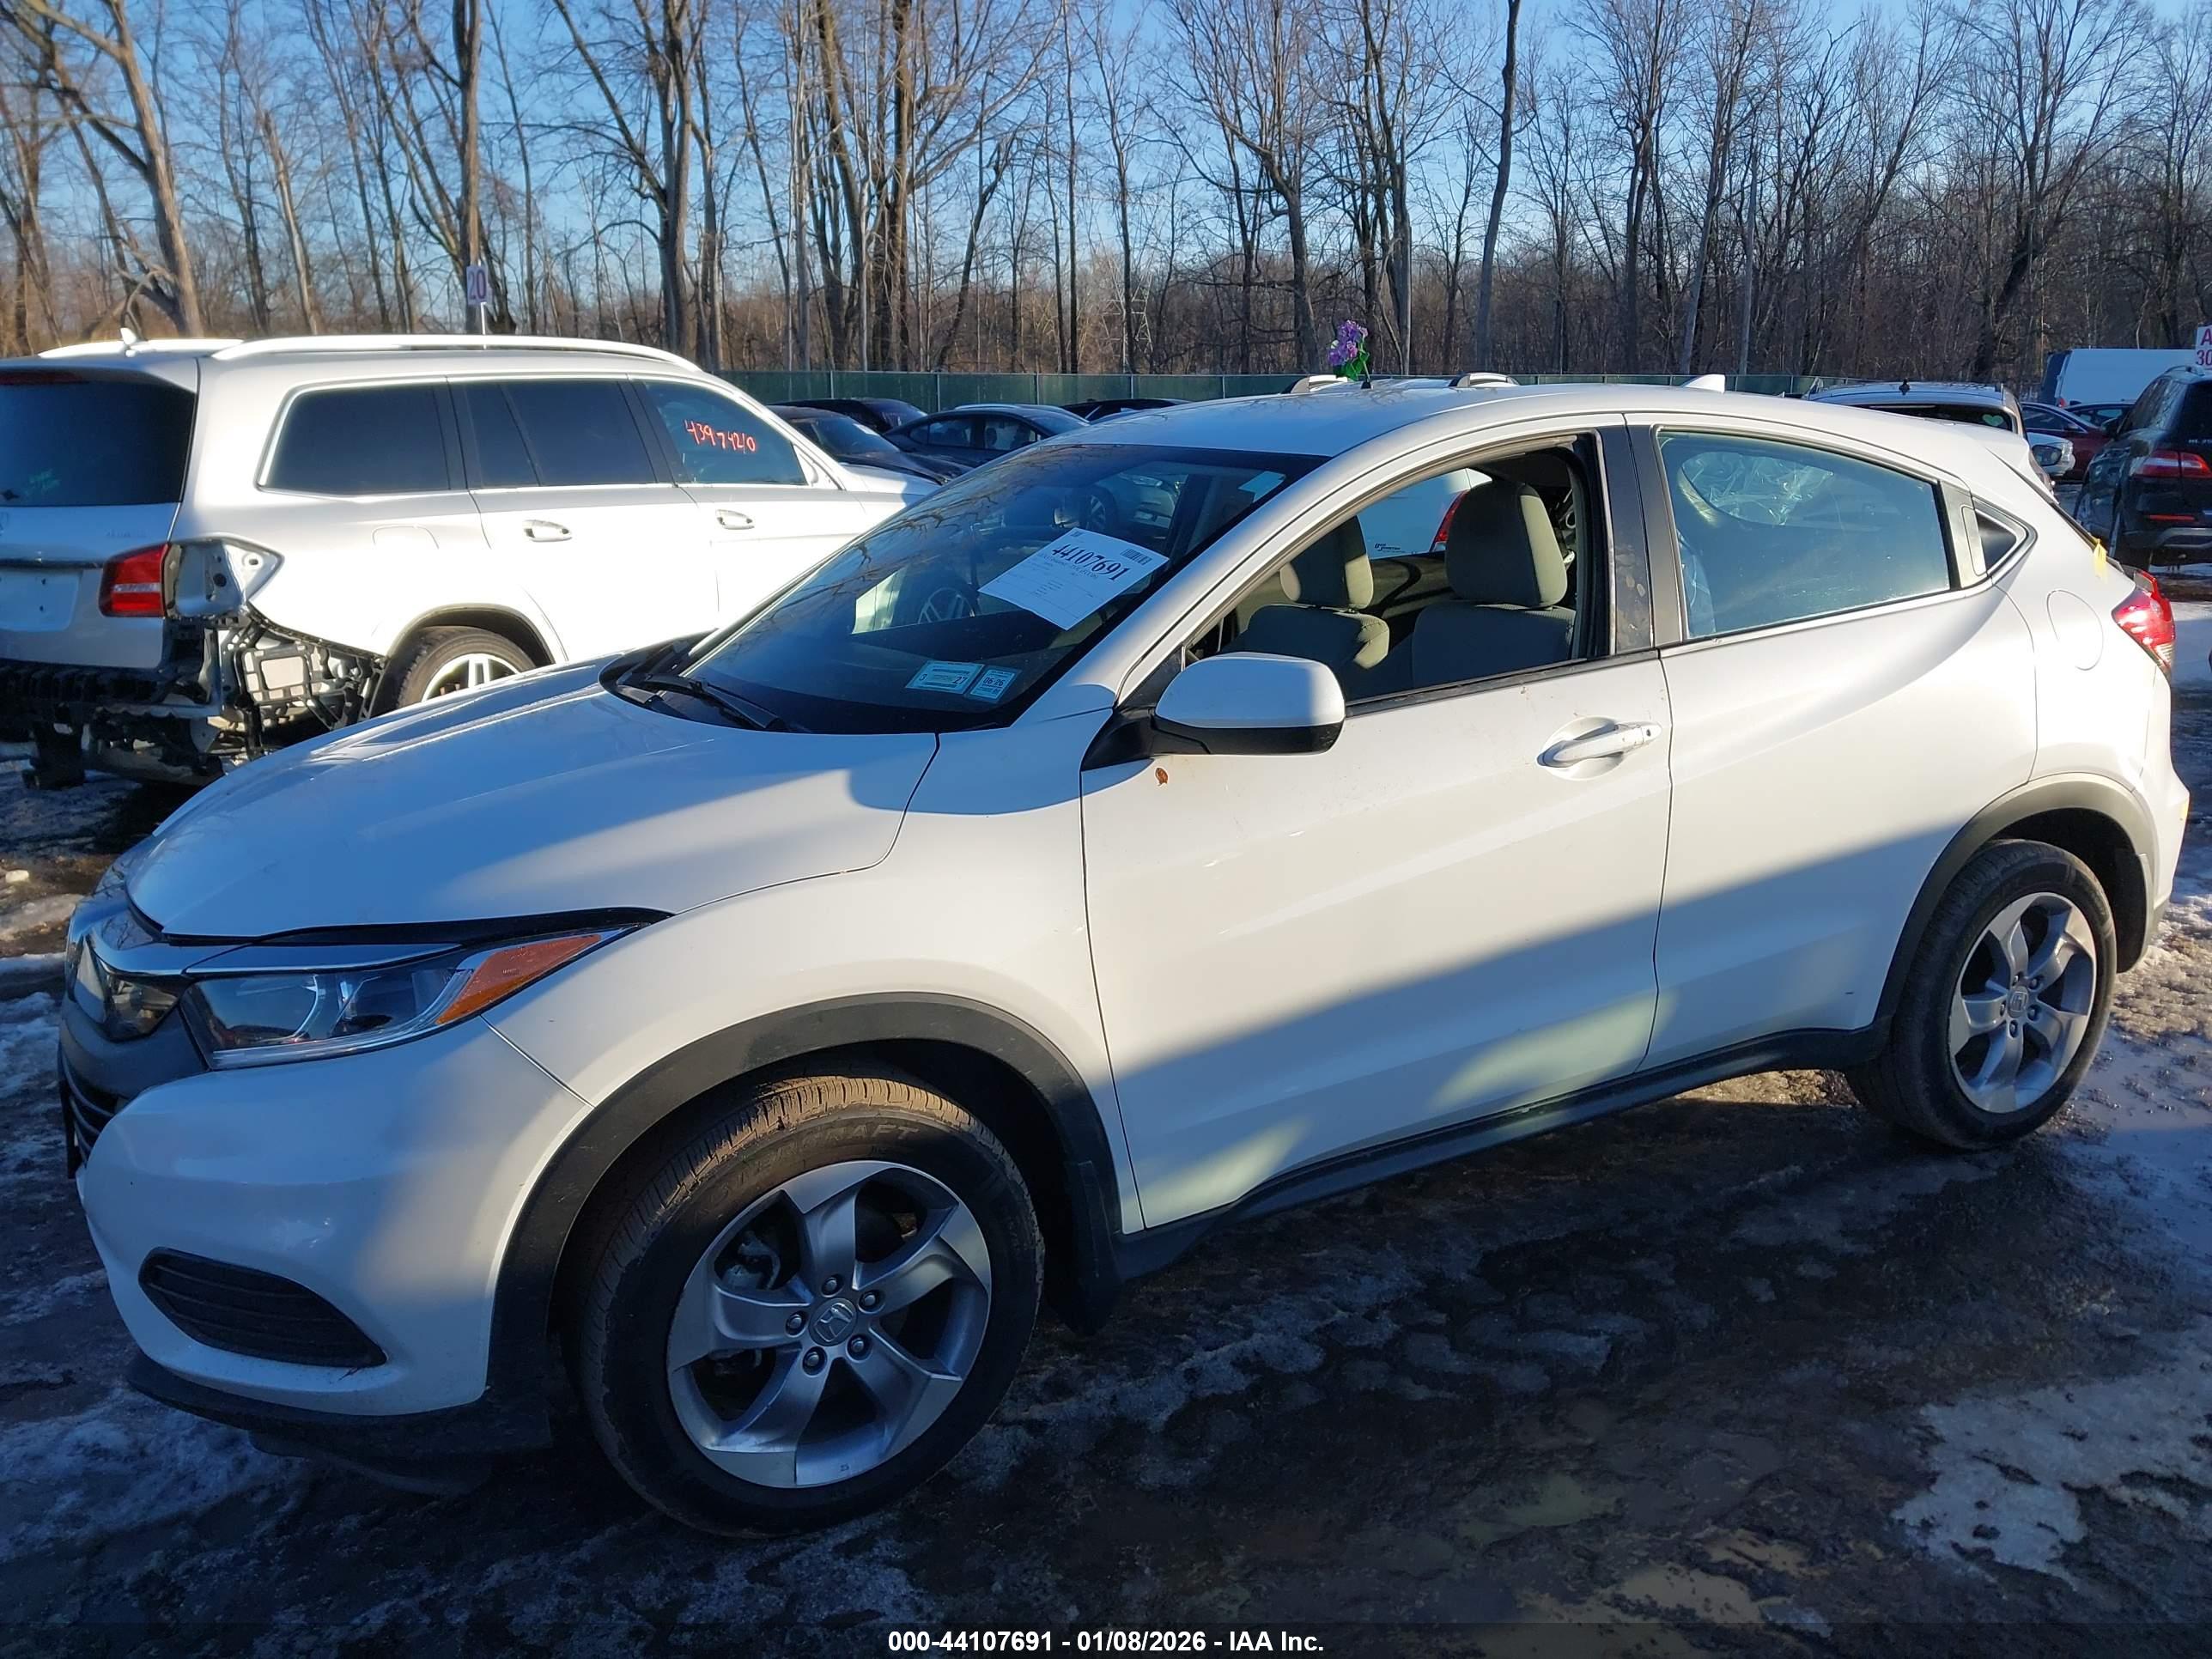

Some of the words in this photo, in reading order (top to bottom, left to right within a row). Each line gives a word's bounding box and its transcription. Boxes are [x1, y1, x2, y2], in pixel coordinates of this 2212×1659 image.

[468, 269, 487, 300] 20
[1052, 543, 1130, 582] 44107691
[952, 675, 969, 685] 27
